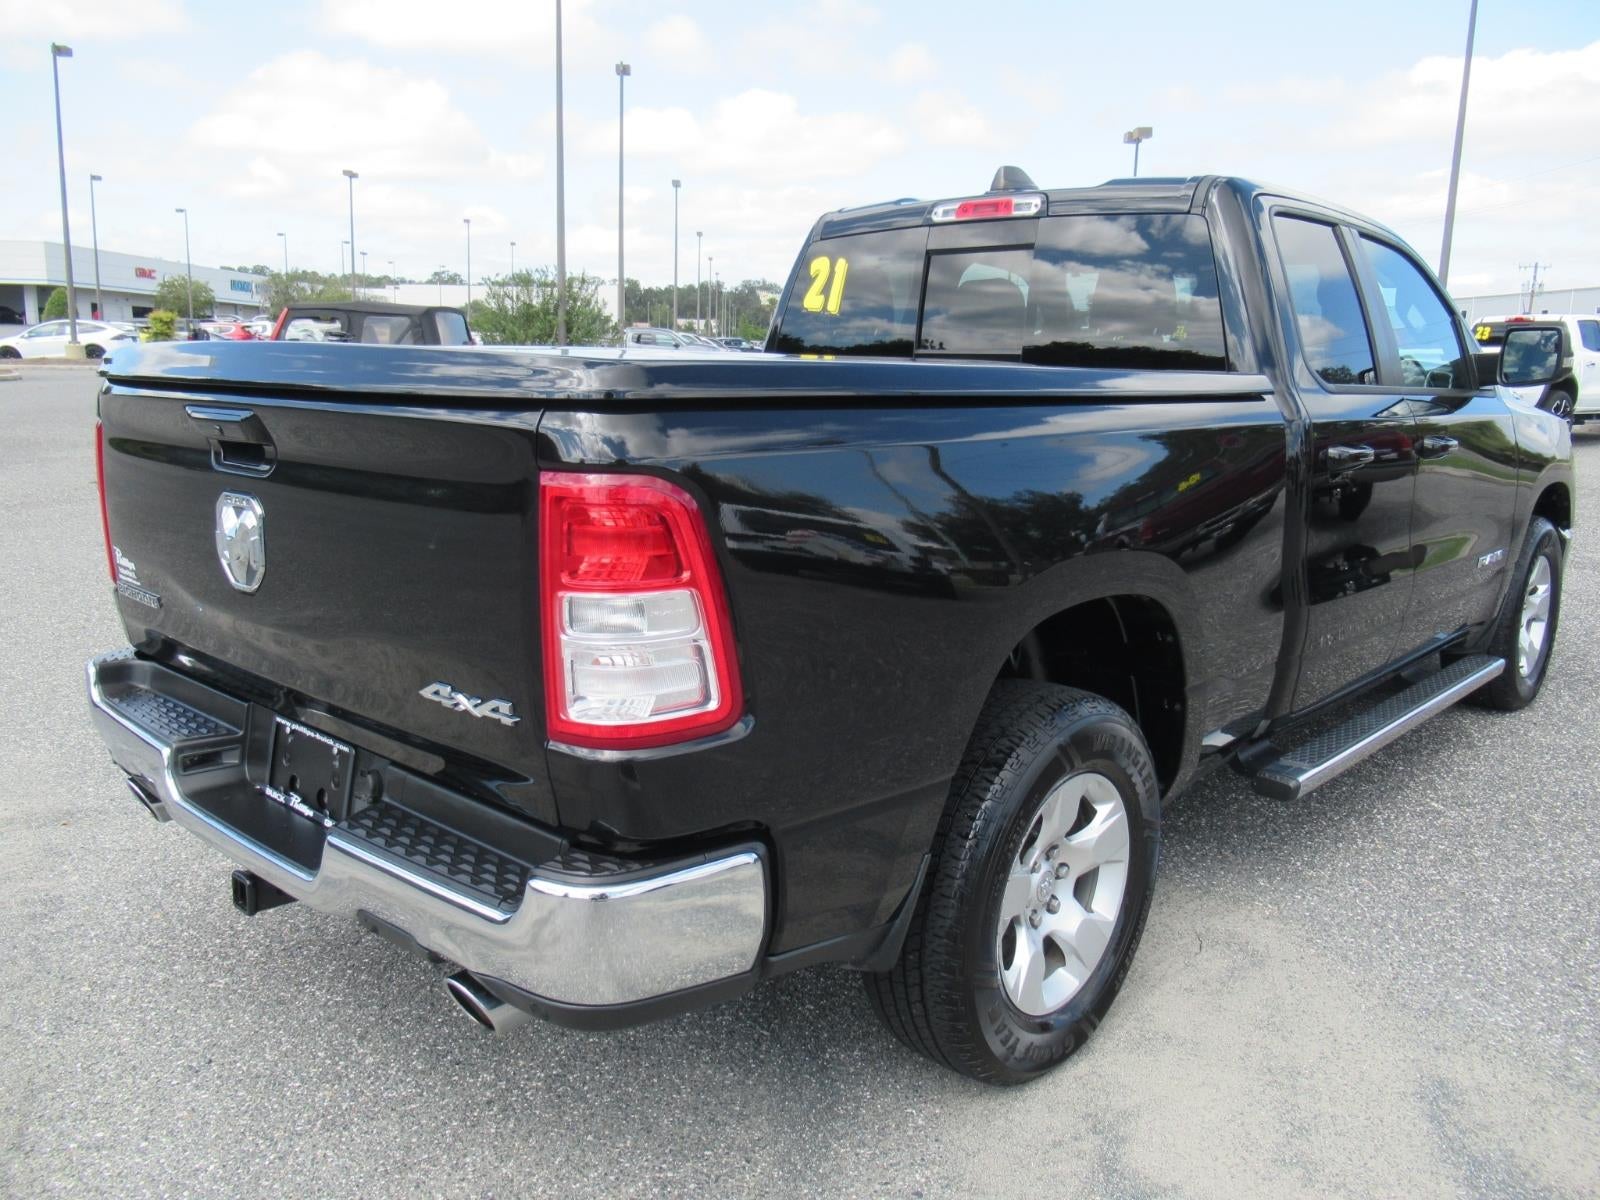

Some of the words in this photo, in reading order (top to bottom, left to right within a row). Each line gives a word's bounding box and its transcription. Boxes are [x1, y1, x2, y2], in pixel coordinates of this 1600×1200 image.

[134, 267, 157, 280] GMC
[803, 256, 848, 314] 21
[1474, 326, 1491, 340] 23
[275, 716, 349, 752] www.phillips-buick.com
[265, 788, 286, 803] BUICK
